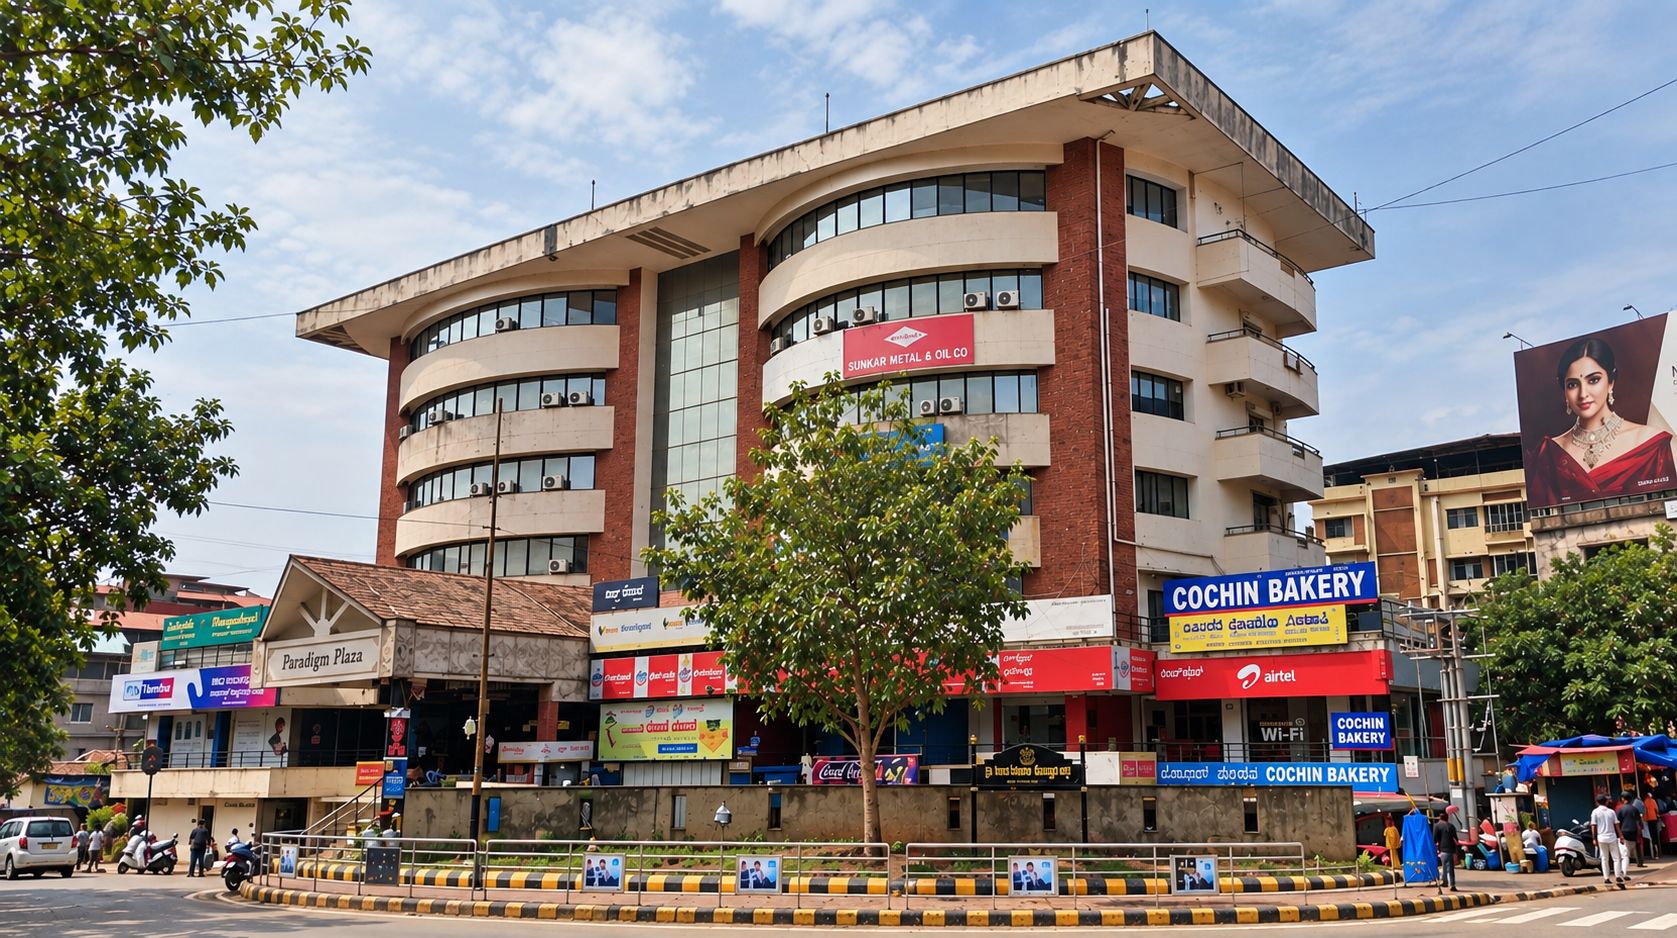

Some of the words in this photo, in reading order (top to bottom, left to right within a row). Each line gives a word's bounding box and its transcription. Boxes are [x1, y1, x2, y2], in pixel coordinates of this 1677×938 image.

[848, 356, 886, 371] SUNKAR
[890, 352, 922, 365] METAL
[935, 348, 951, 360] OIL
[953, 347, 968, 358] CO
[1172, 580, 1259, 611] COCHIN
[1268, 570, 1366, 603] BAKERY
[282, 652, 330, 672] Paradigm
[333, 647, 363, 665] Plaza
[1264, 669, 1297, 683] airtel
[1337, 717, 1384, 730] COCHIN
[1260, 727, 1304, 742] Wi-Fi
[1338, 732, 1386, 744] BAKERY
[1266, 766, 1323, 782] COCHIN
[1327, 766, 1390, 783] BAKERY
